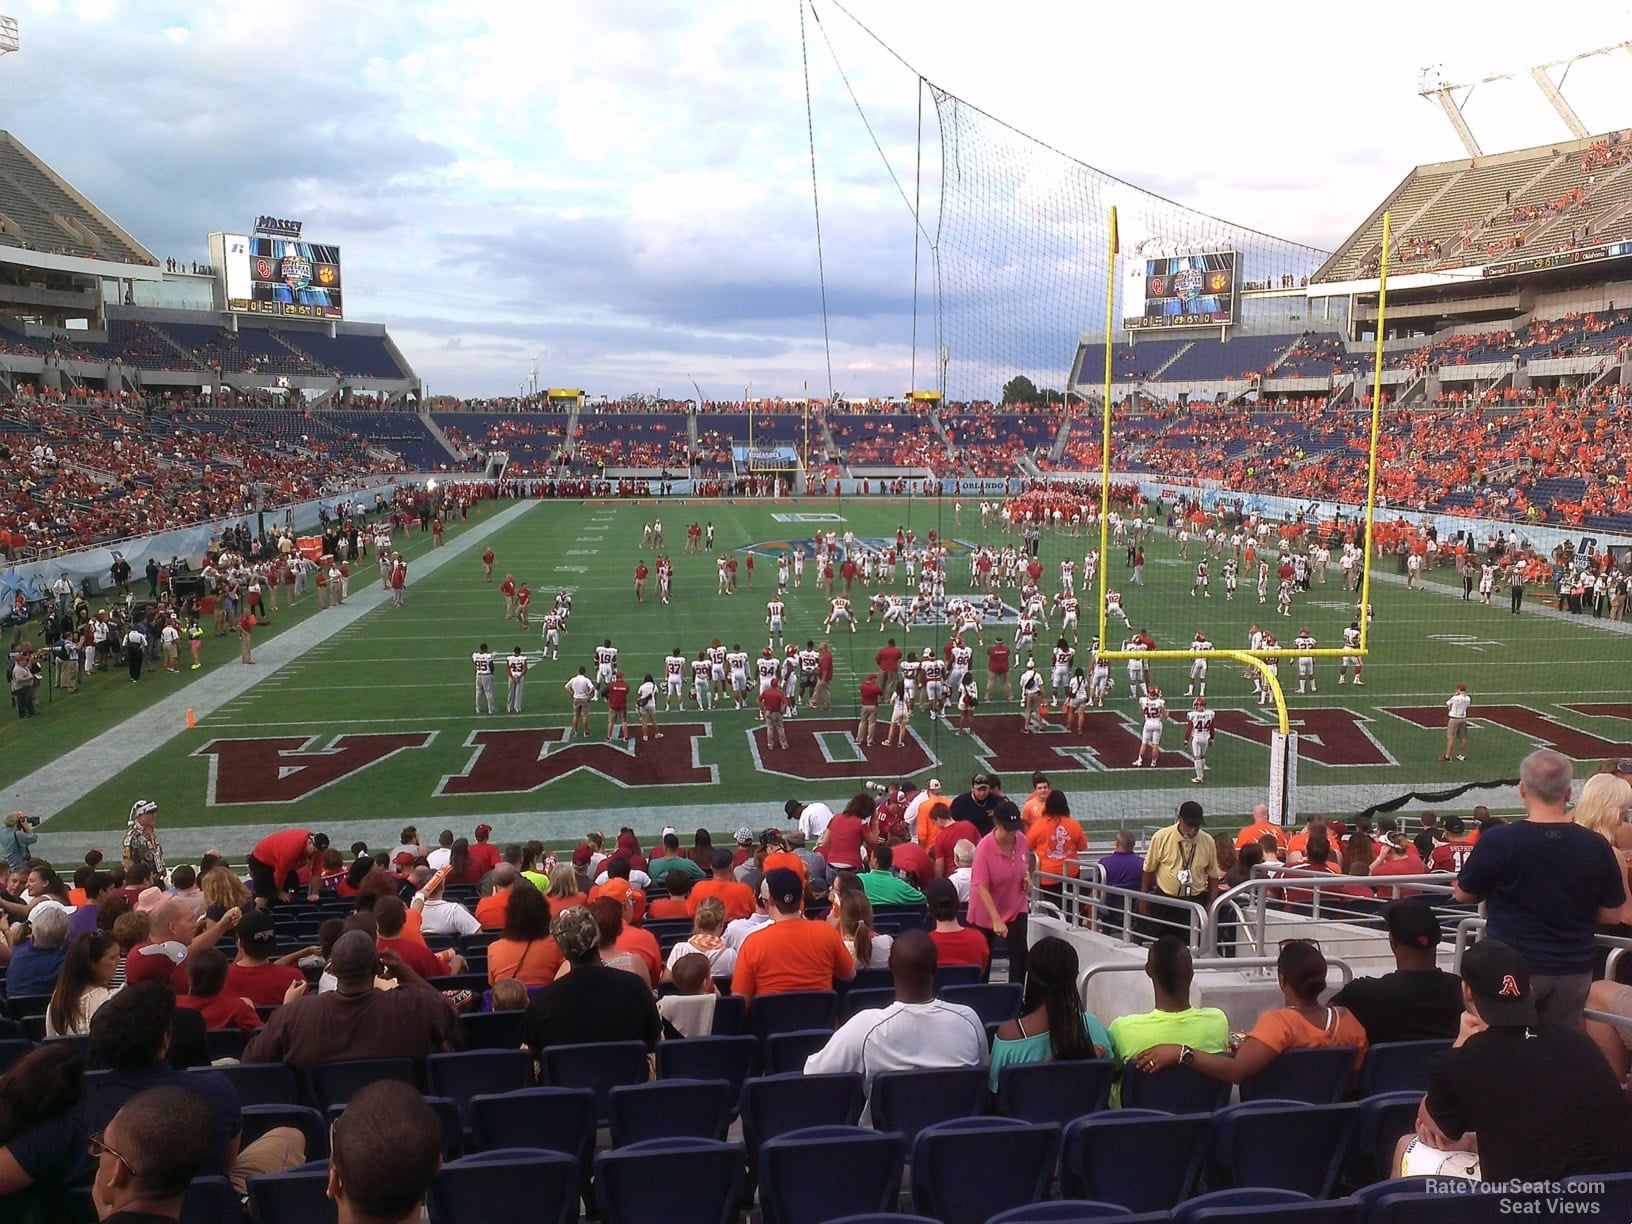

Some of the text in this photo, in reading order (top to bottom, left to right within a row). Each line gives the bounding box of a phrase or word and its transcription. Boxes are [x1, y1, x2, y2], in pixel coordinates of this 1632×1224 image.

[257, 215, 302, 232] MASSEY
[1582, 251, 1605, 260] Oklahoma
[962, 482, 1004, 490] ORLNDO
[772, 605, 779, 616] 11
[601, 653, 611, 664] 19
[713, 653, 723, 664] 15
[803, 658, 815, 667] 59
[475, 660, 487, 671] 95
[510, 662, 523, 672] 43
[668, 663, 680, 674] 37
[760, 666, 774, 677] 94
[1143, 707, 1160, 718] 42
[1195, 720, 1211, 732] 44
[190, 702, 1632, 807] LAHOMA
[1499, 975, 1520, 997] A
